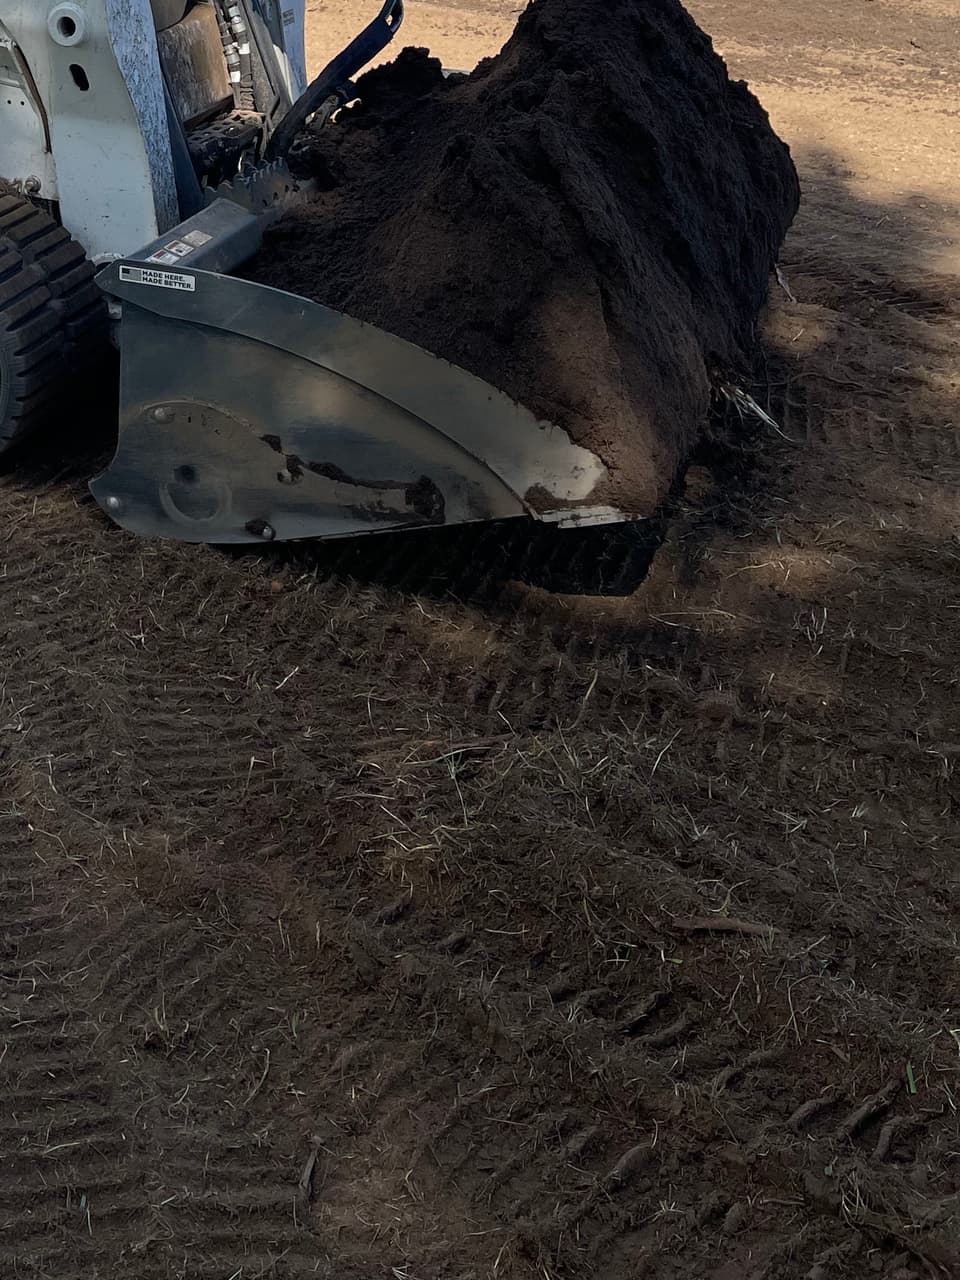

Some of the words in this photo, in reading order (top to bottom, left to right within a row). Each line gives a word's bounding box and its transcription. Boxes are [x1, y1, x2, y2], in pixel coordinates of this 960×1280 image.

[142, 270, 163, 278] MADE
[164, 274, 186, 282] HERE.
[142, 276, 163, 285] MADE
[164, 280, 193, 289] BETTER.
